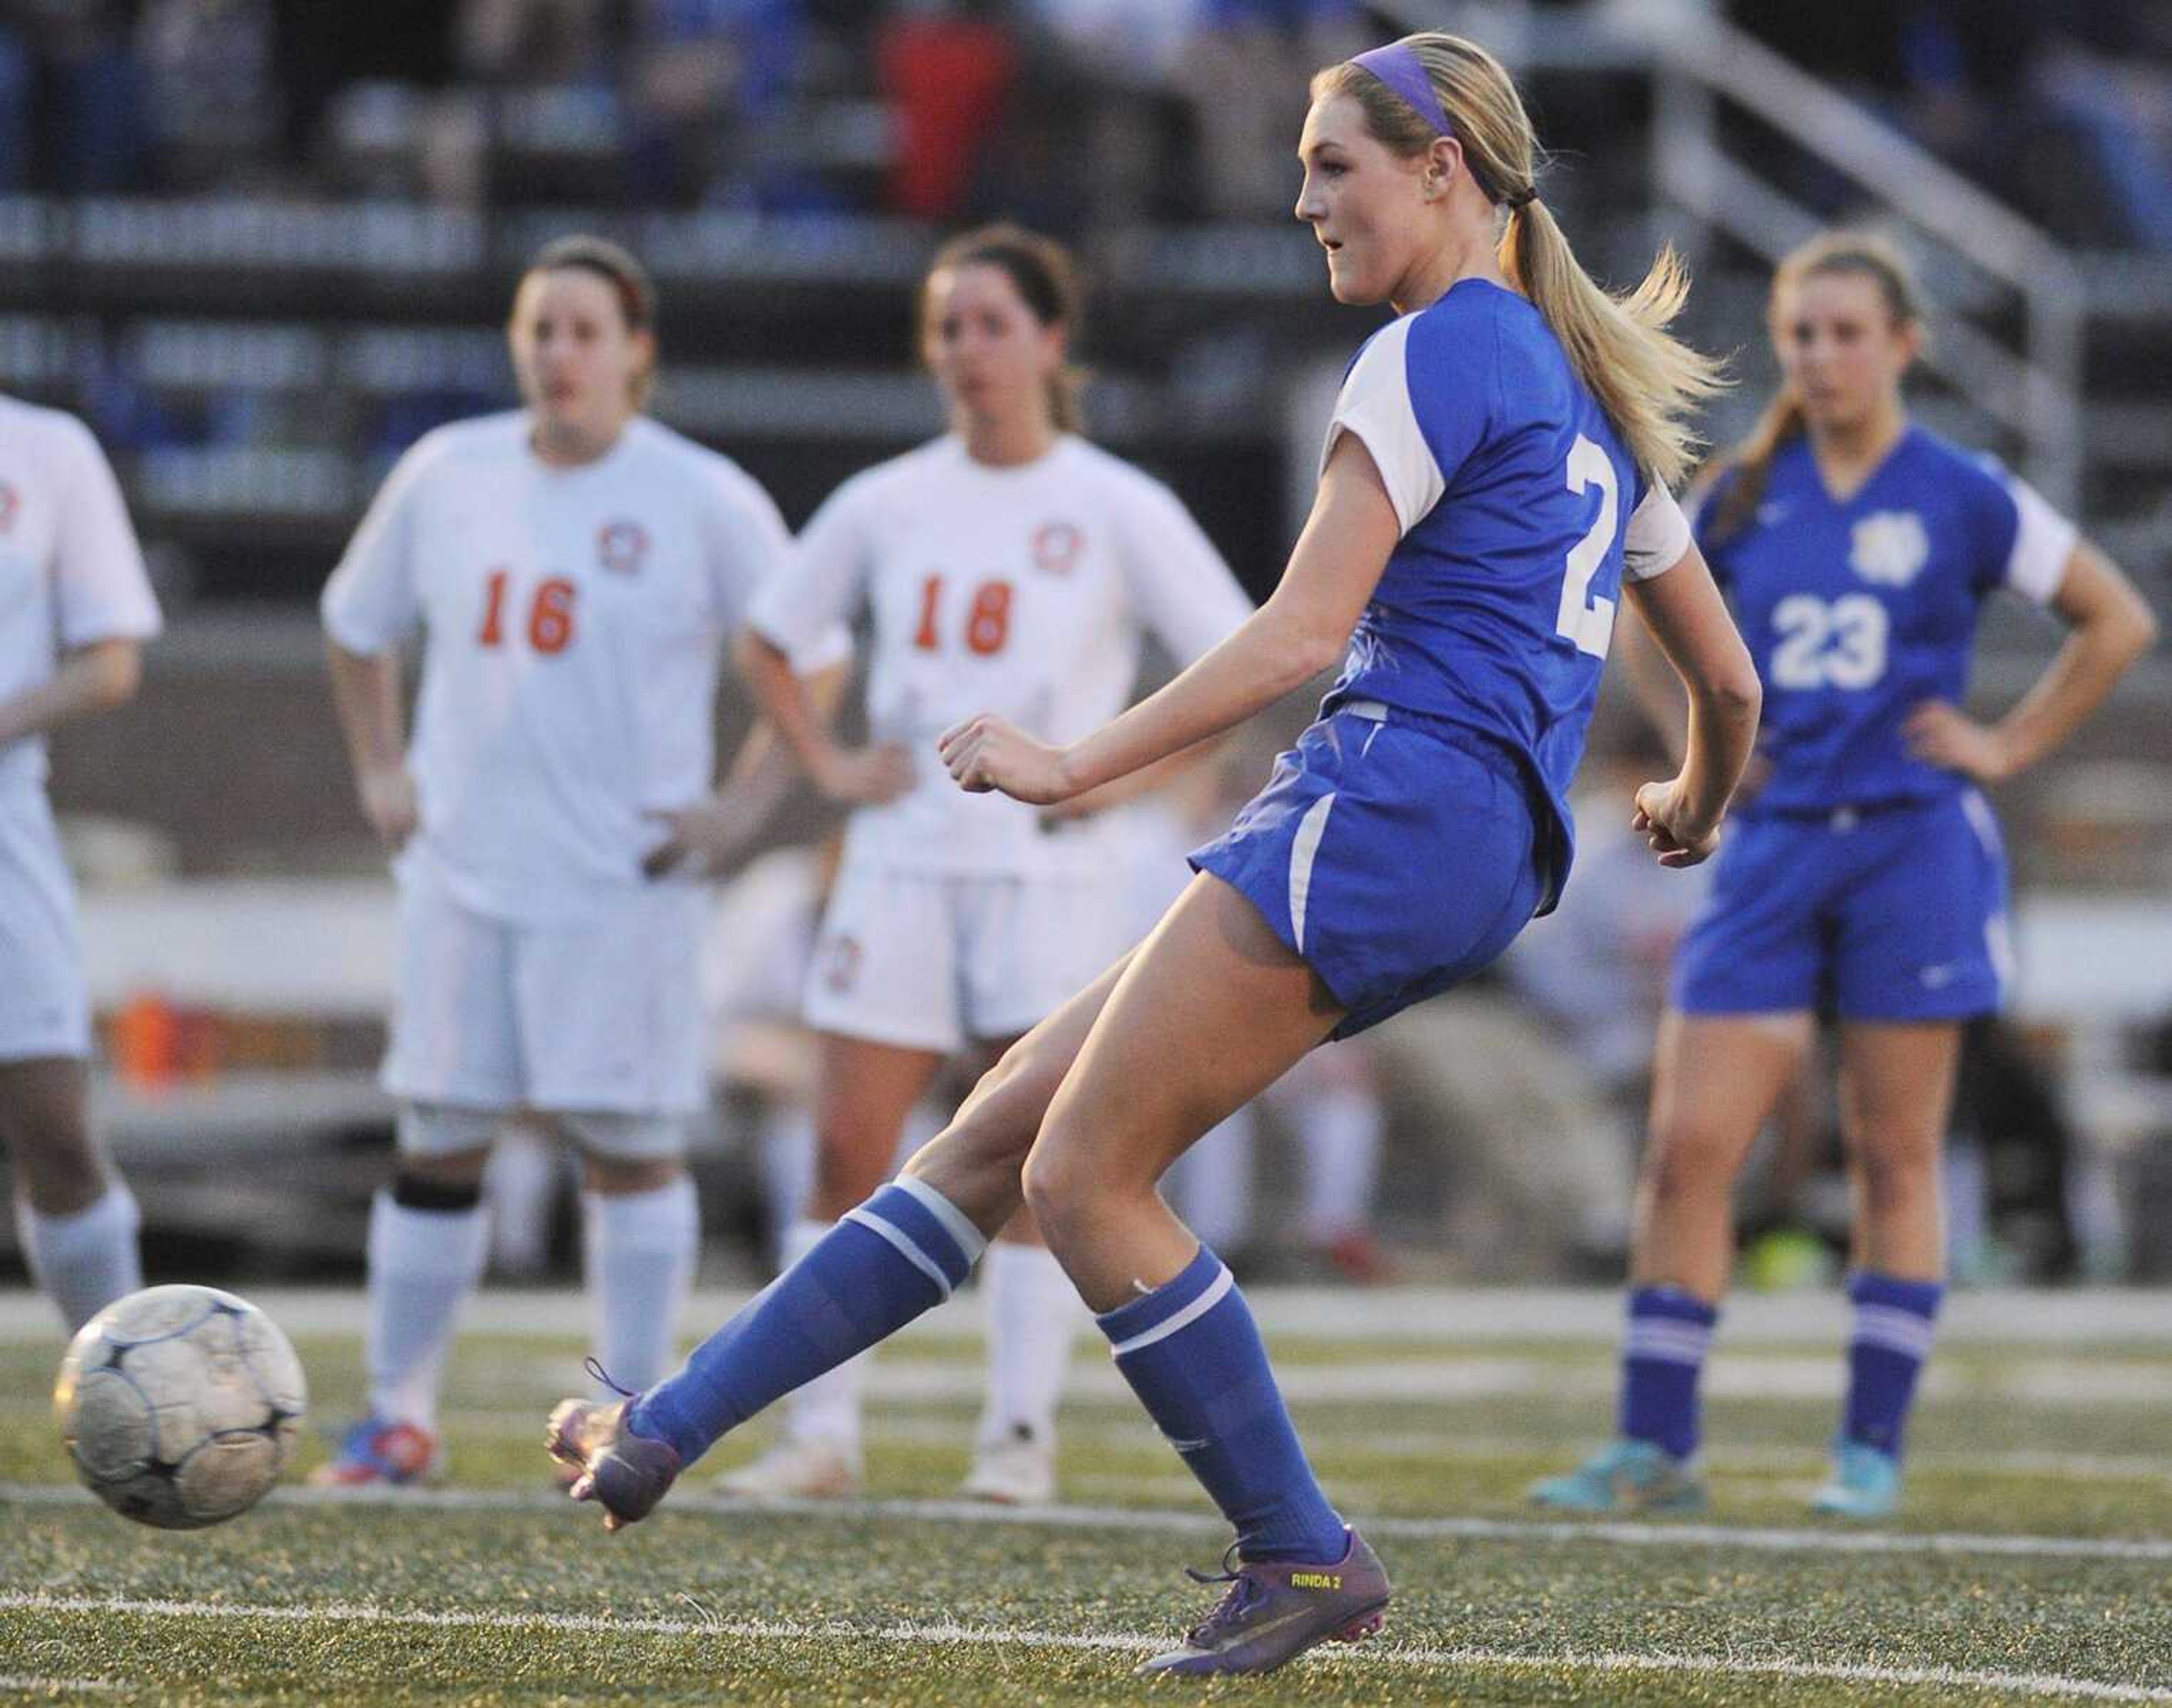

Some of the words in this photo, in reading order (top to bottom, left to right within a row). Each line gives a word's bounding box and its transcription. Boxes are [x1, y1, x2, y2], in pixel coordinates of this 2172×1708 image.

[1556, 433, 1617, 660] 2
[478, 568, 576, 656] 16
[914, 570, 1012, 657] 18
[1772, 594, 1889, 690] 23
[1291, 1572, 1330, 1589] RINDA
[1332, 1575, 1342, 1590] 2
